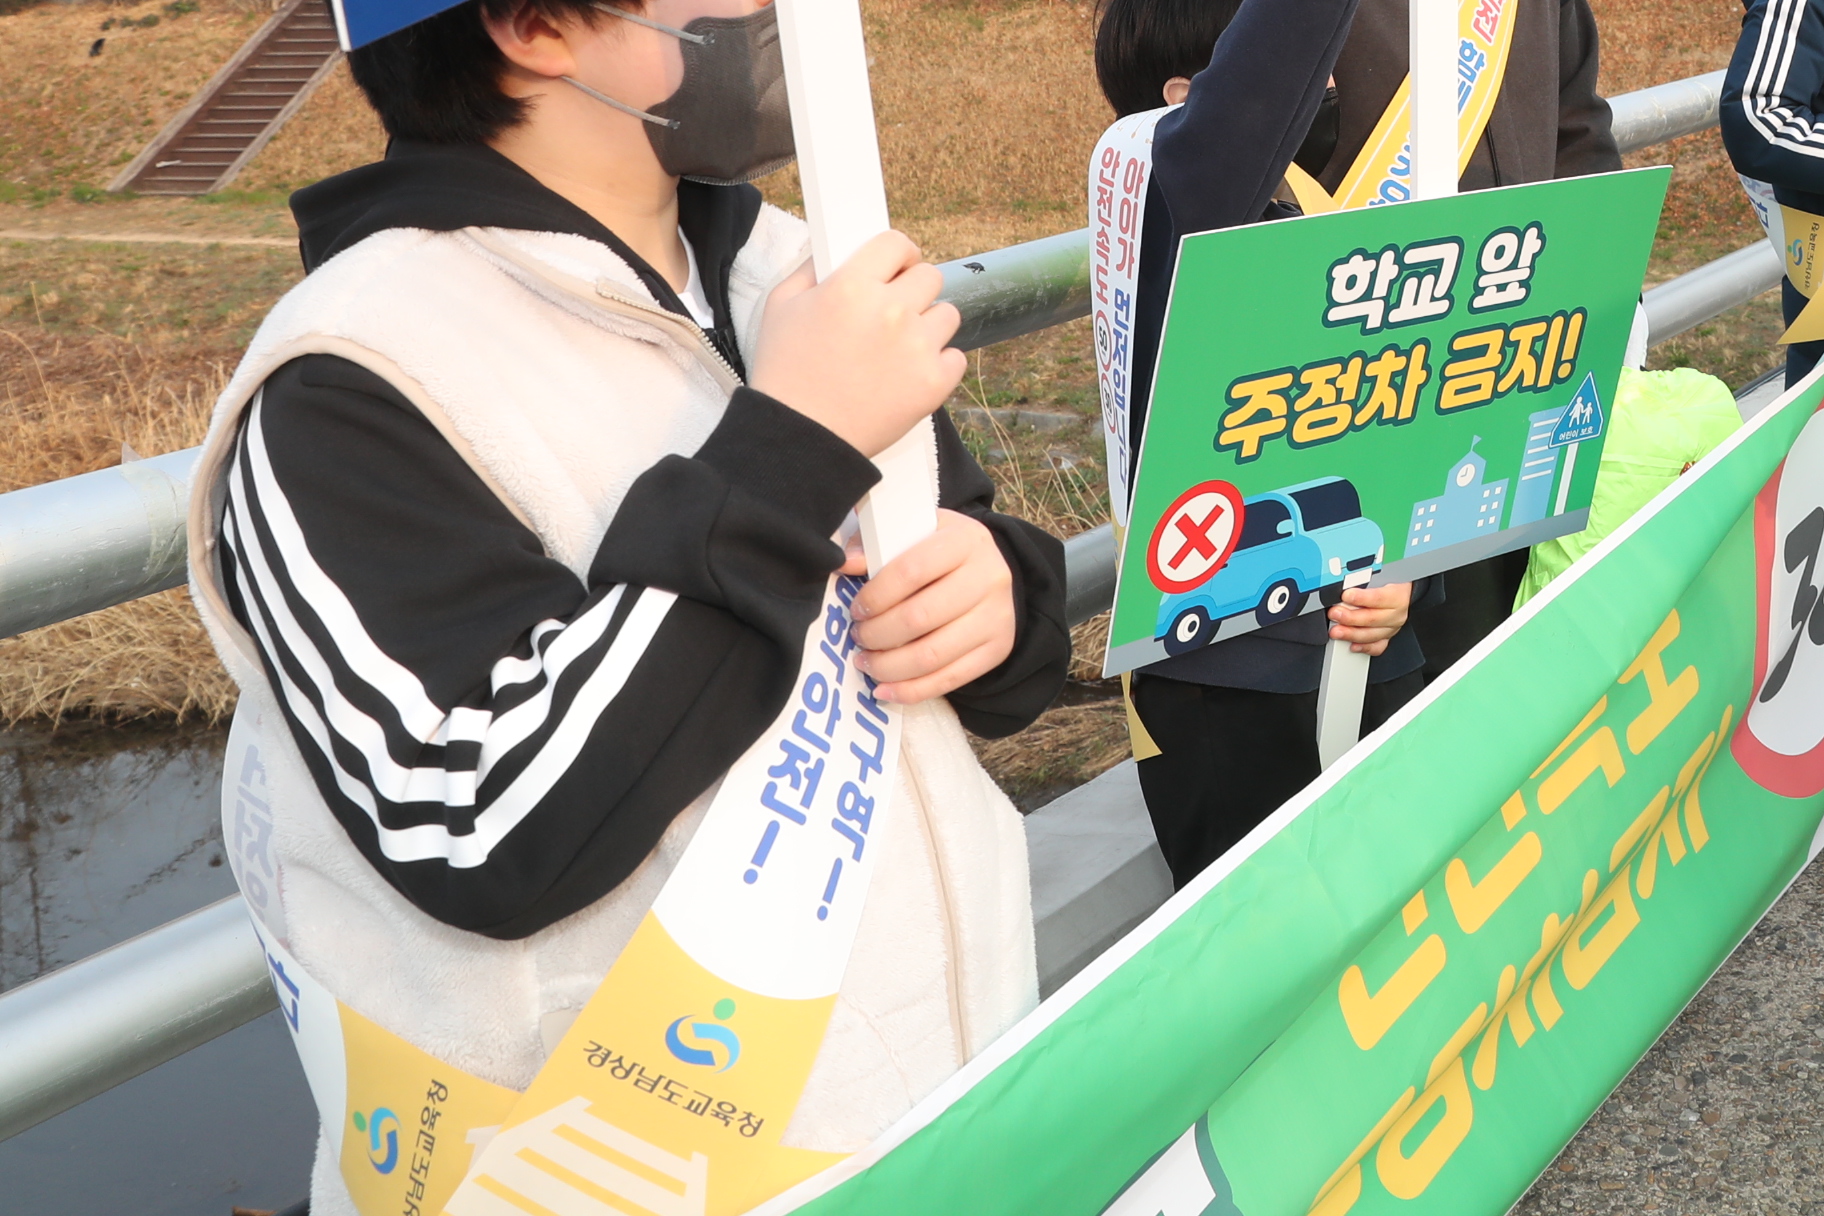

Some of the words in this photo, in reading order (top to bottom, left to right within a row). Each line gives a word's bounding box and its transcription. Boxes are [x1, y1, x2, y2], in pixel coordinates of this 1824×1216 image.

[1096, 146, 1121, 305] 안전속도
[1115, 157, 1145, 280] 아이가
[1324, 234, 1460, 331] 학교
[1472, 224, 1543, 312] 앞
[1217, 342, 1427, 459] 주정차
[1438, 310, 1585, 411] 금지!
[1558, 428, 1579, 441] 어린이
[402, 1078, 449, 1216] 상남도교육청
[582, 1039, 765, 1138] 경상남도교육청
